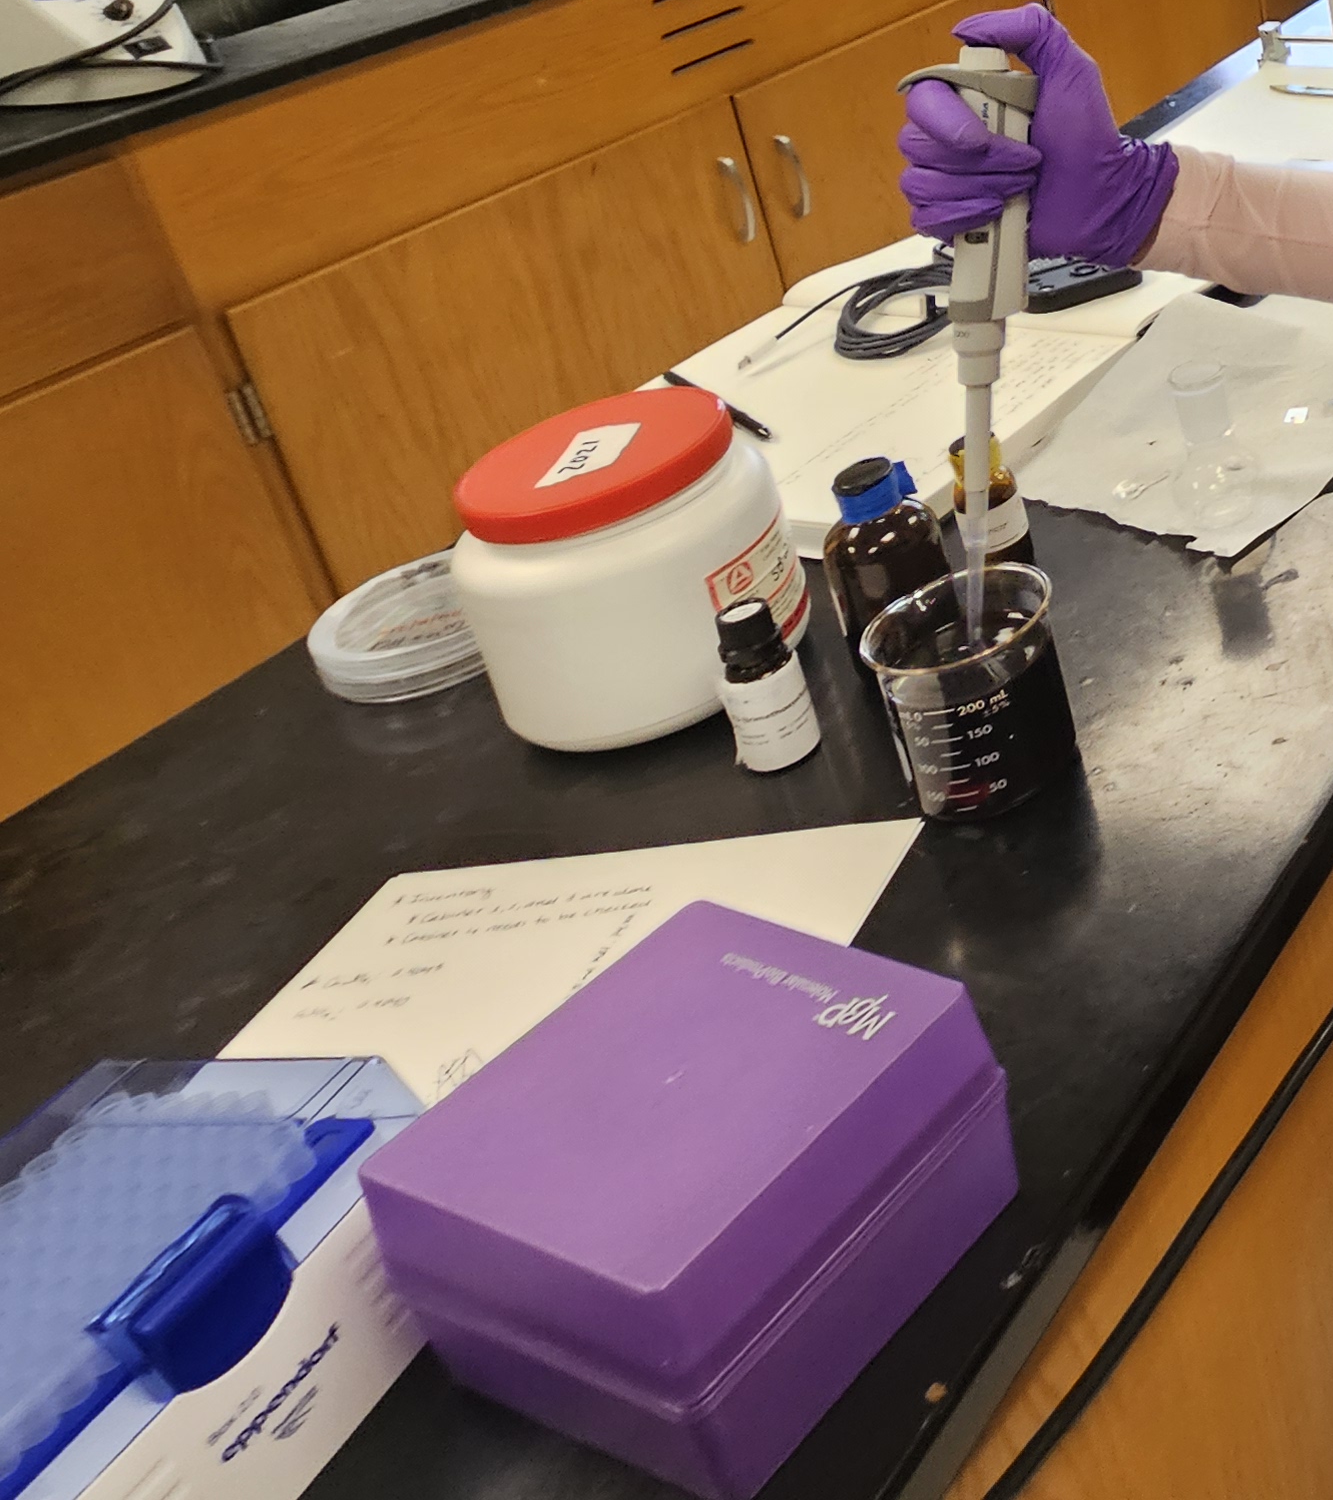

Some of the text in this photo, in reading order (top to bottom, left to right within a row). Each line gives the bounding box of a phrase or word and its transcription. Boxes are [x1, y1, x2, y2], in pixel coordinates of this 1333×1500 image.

[558, 440, 600, 474] 2021
[956, 689, 1009, 717] 200 mL
[966, 724, 993, 740] 150
[974, 751, 1000, 767] 100
[988, 778, 1008, 793] 50
[781, 973, 839, 1004] Molecular
[221, 1321, 342, 1463] eppendorf
